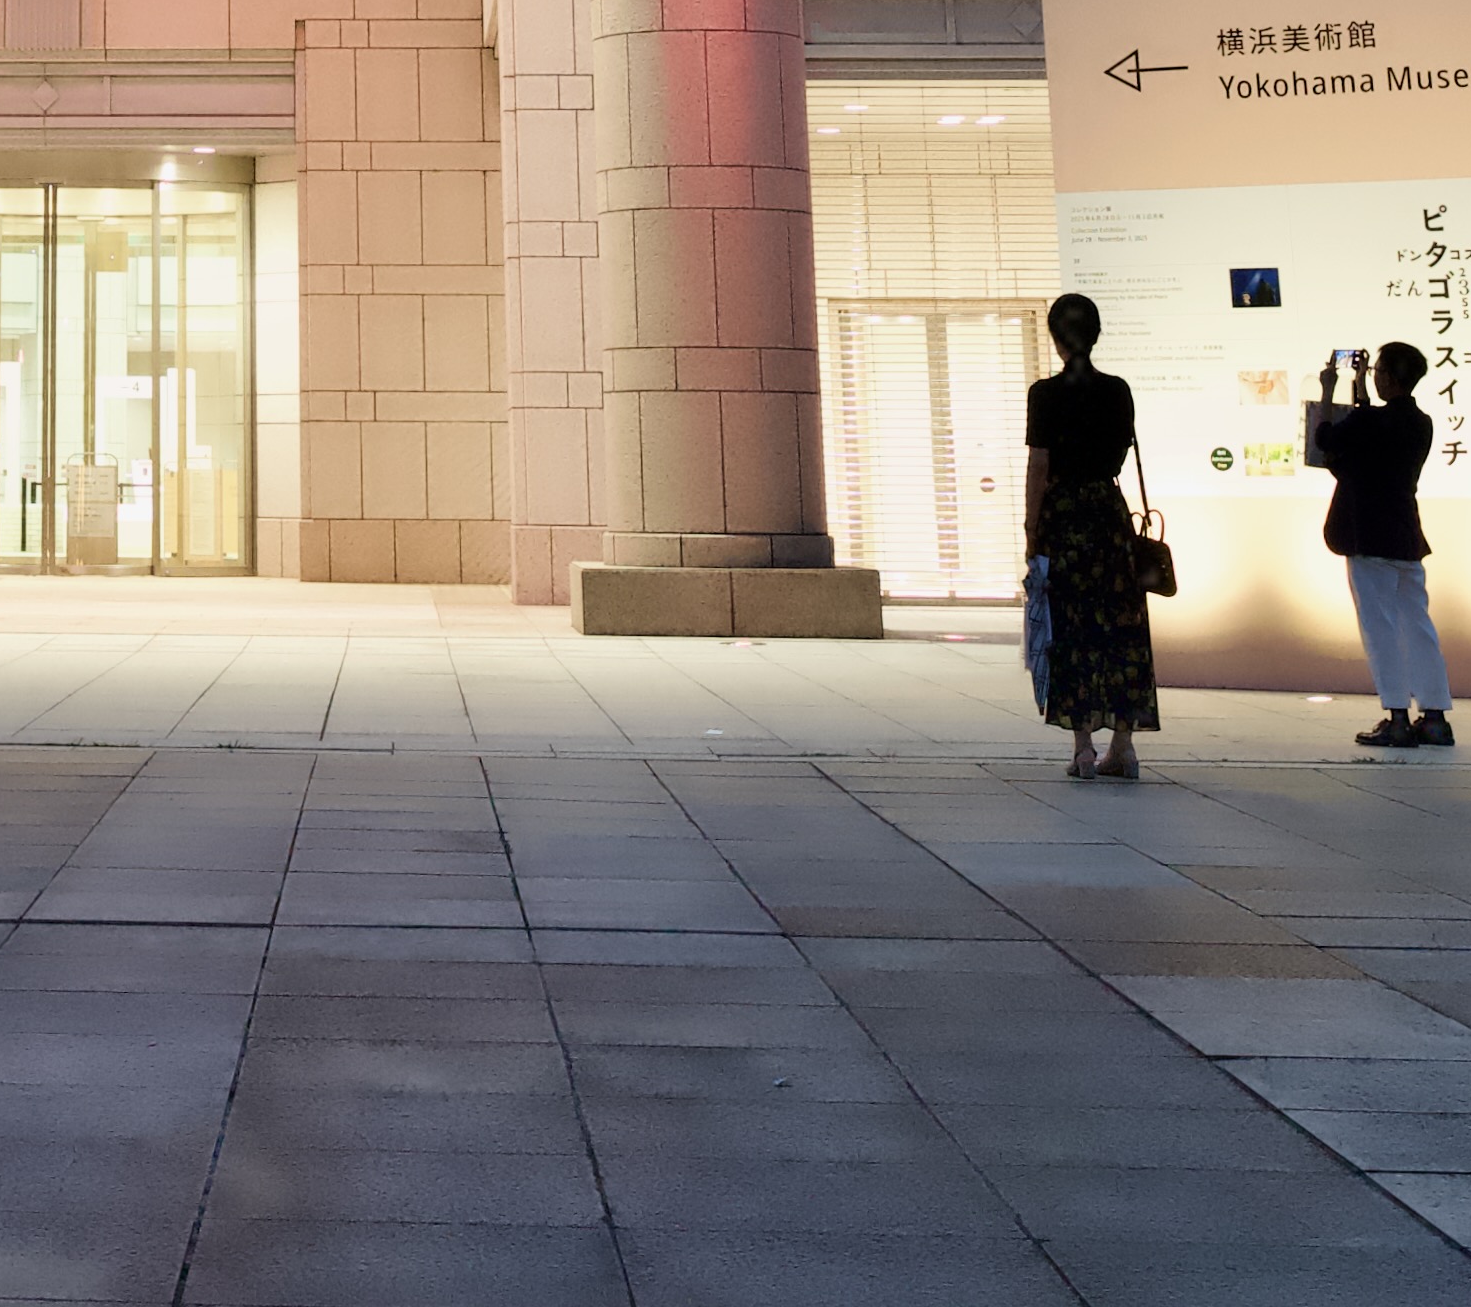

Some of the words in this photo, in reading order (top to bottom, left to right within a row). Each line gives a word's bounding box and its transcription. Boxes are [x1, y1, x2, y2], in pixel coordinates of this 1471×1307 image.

[1217, 20, 1377, 57] 横浜美術館
[1219, 71, 1375, 100] Yokohama
